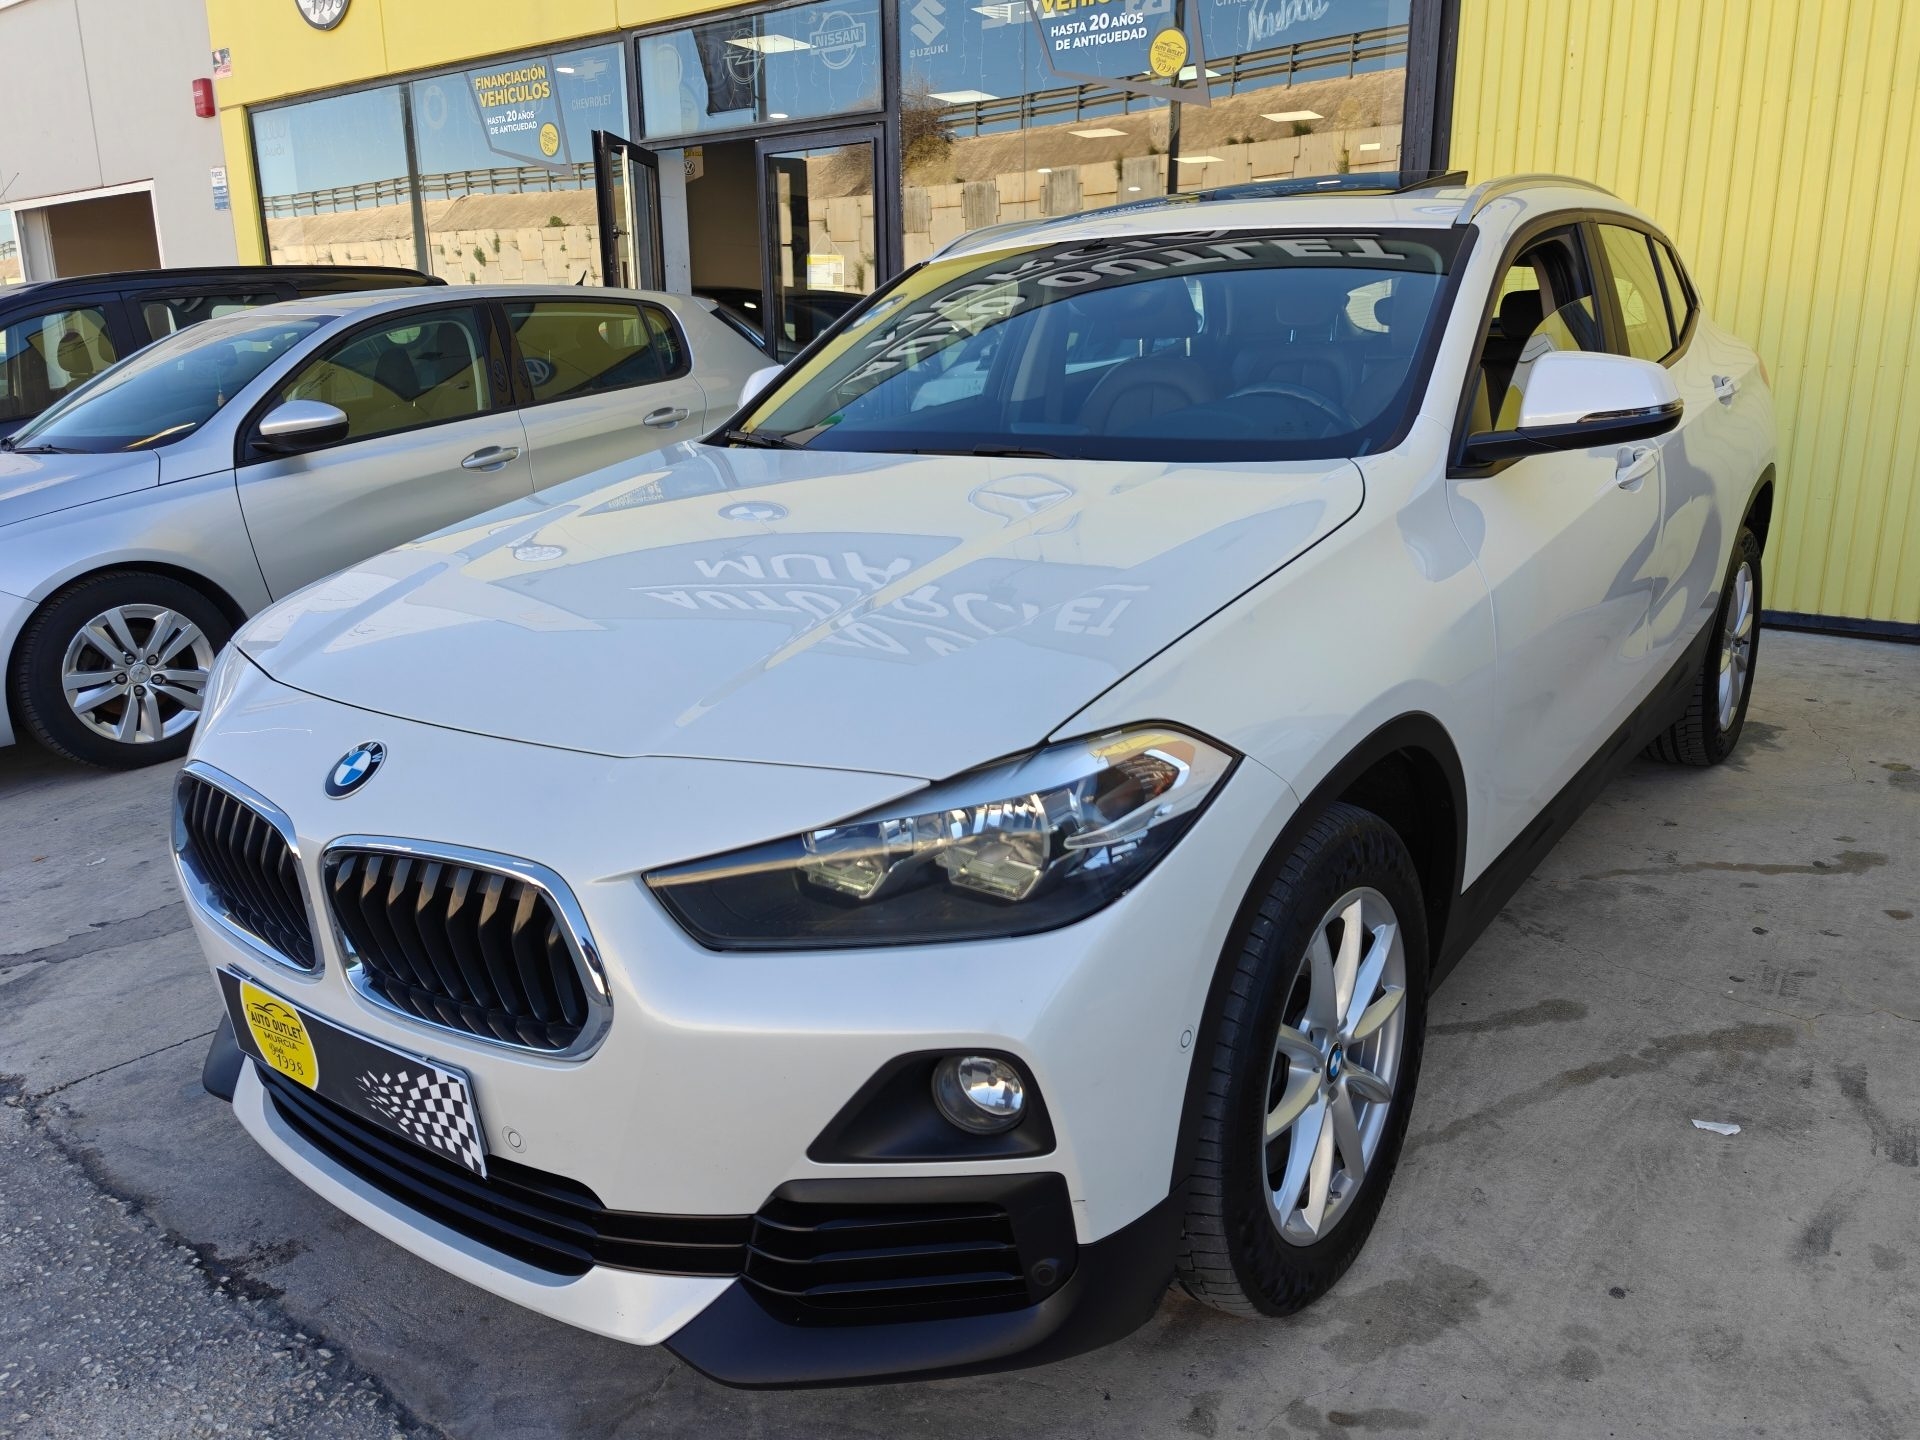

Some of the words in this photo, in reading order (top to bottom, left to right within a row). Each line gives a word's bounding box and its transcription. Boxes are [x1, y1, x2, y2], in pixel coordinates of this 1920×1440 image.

[1051, 22, 1087, 37] HASTA
[1089, 13, 1110, 31] 20
[1111, 12, 1144, 28] AÑOS
[815, 28, 859, 47] NISSAN
[1055, 38, 1071, 51] DE
[1072, 27, 1148, 49] ANTIGUEDAD
[909, 44, 949, 58] SUZUKI
[475, 64, 546, 90] FINANCIACIÓN
[479, 81, 551, 108] VEHÍCULOS
[571, 94, 612, 110] CHEVROLET
[487, 115, 506, 126] HASTA
[506, 110, 517, 122] 20
[517, 110, 535, 120] AÑOS
[490, 126, 499, 135] DE
[499, 121, 538, 133] ANTIGUEDAD
[250, 1011, 271, 1028] AUTO
[272, 1019, 302, 1040] OUTLET
[263, 1031, 299, 1051] MURCIA
[277, 1054, 304, 1076] 1998
